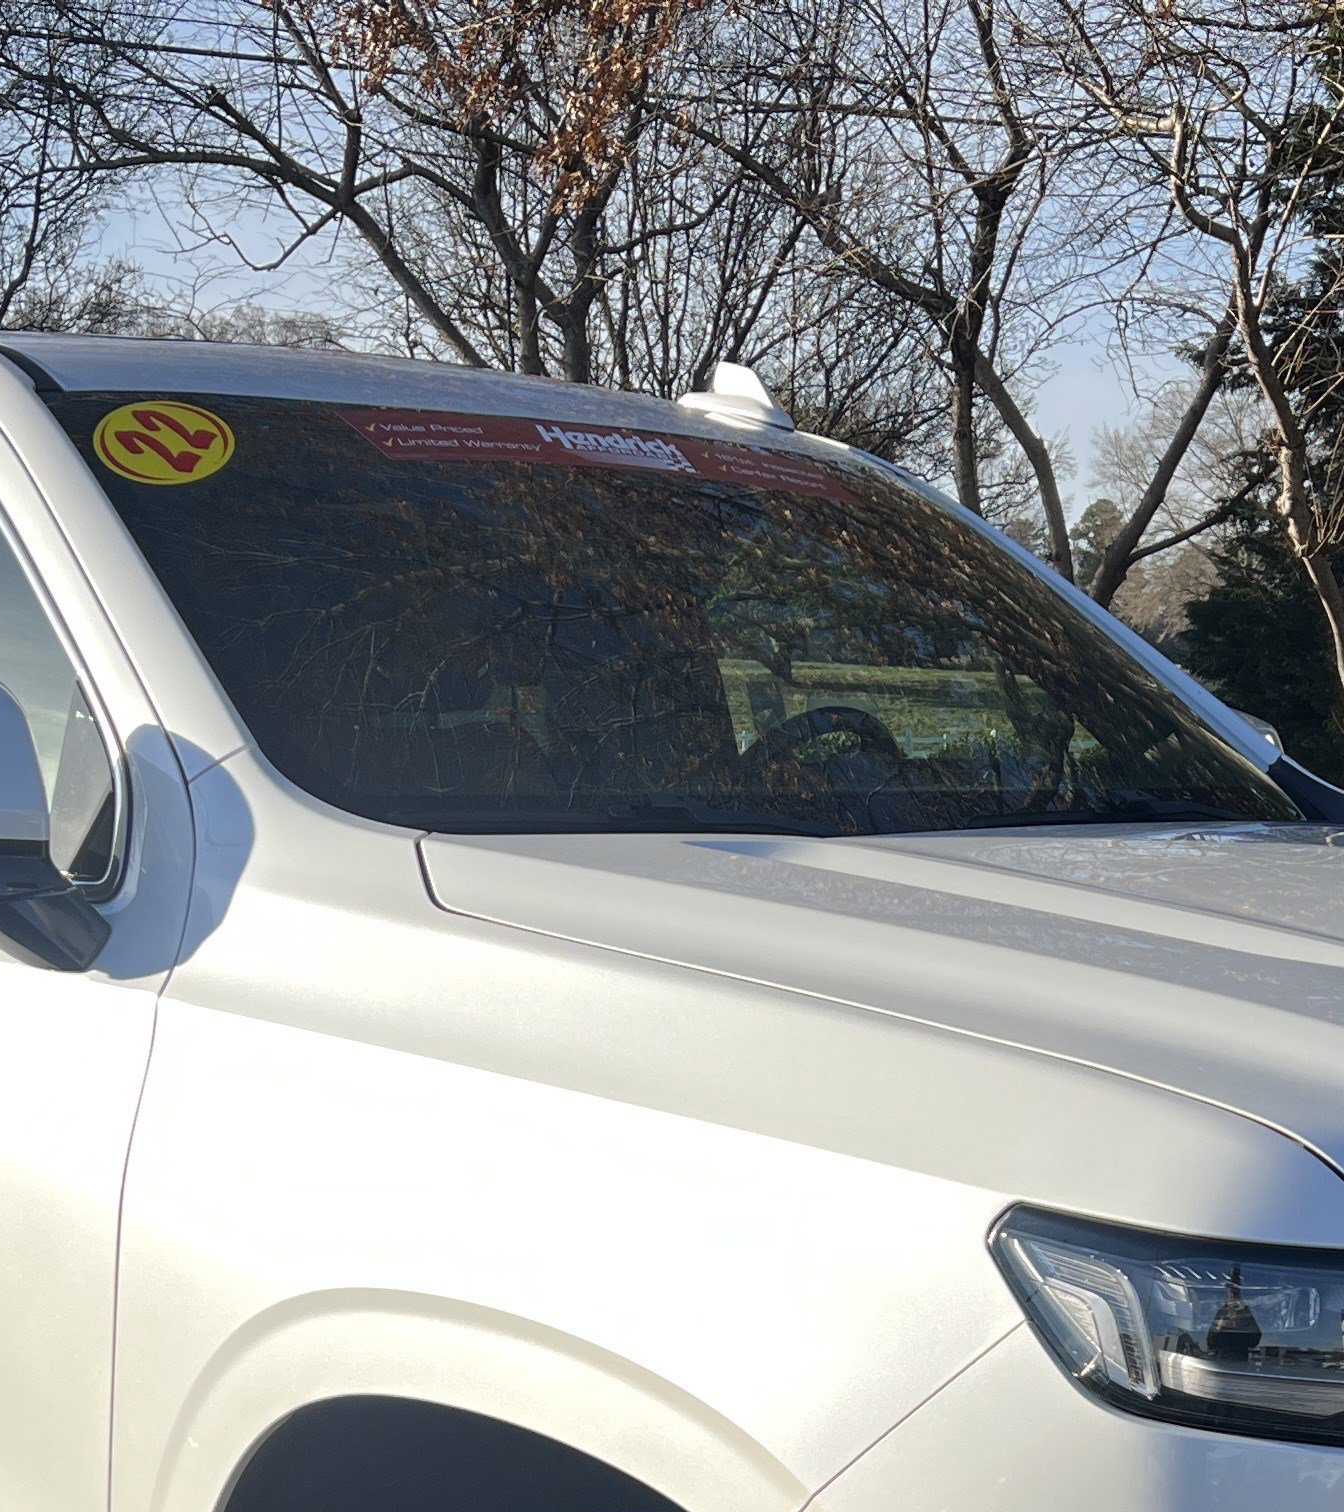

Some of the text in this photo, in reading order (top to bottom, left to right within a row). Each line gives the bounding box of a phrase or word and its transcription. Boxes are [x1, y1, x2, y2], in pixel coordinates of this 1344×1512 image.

[378, 422, 484, 435] Value Priced
[114, 410, 219, 474] 22
[396, 437, 542, 452] Limited Warranty
[534, 424, 690, 462] Hendrick
